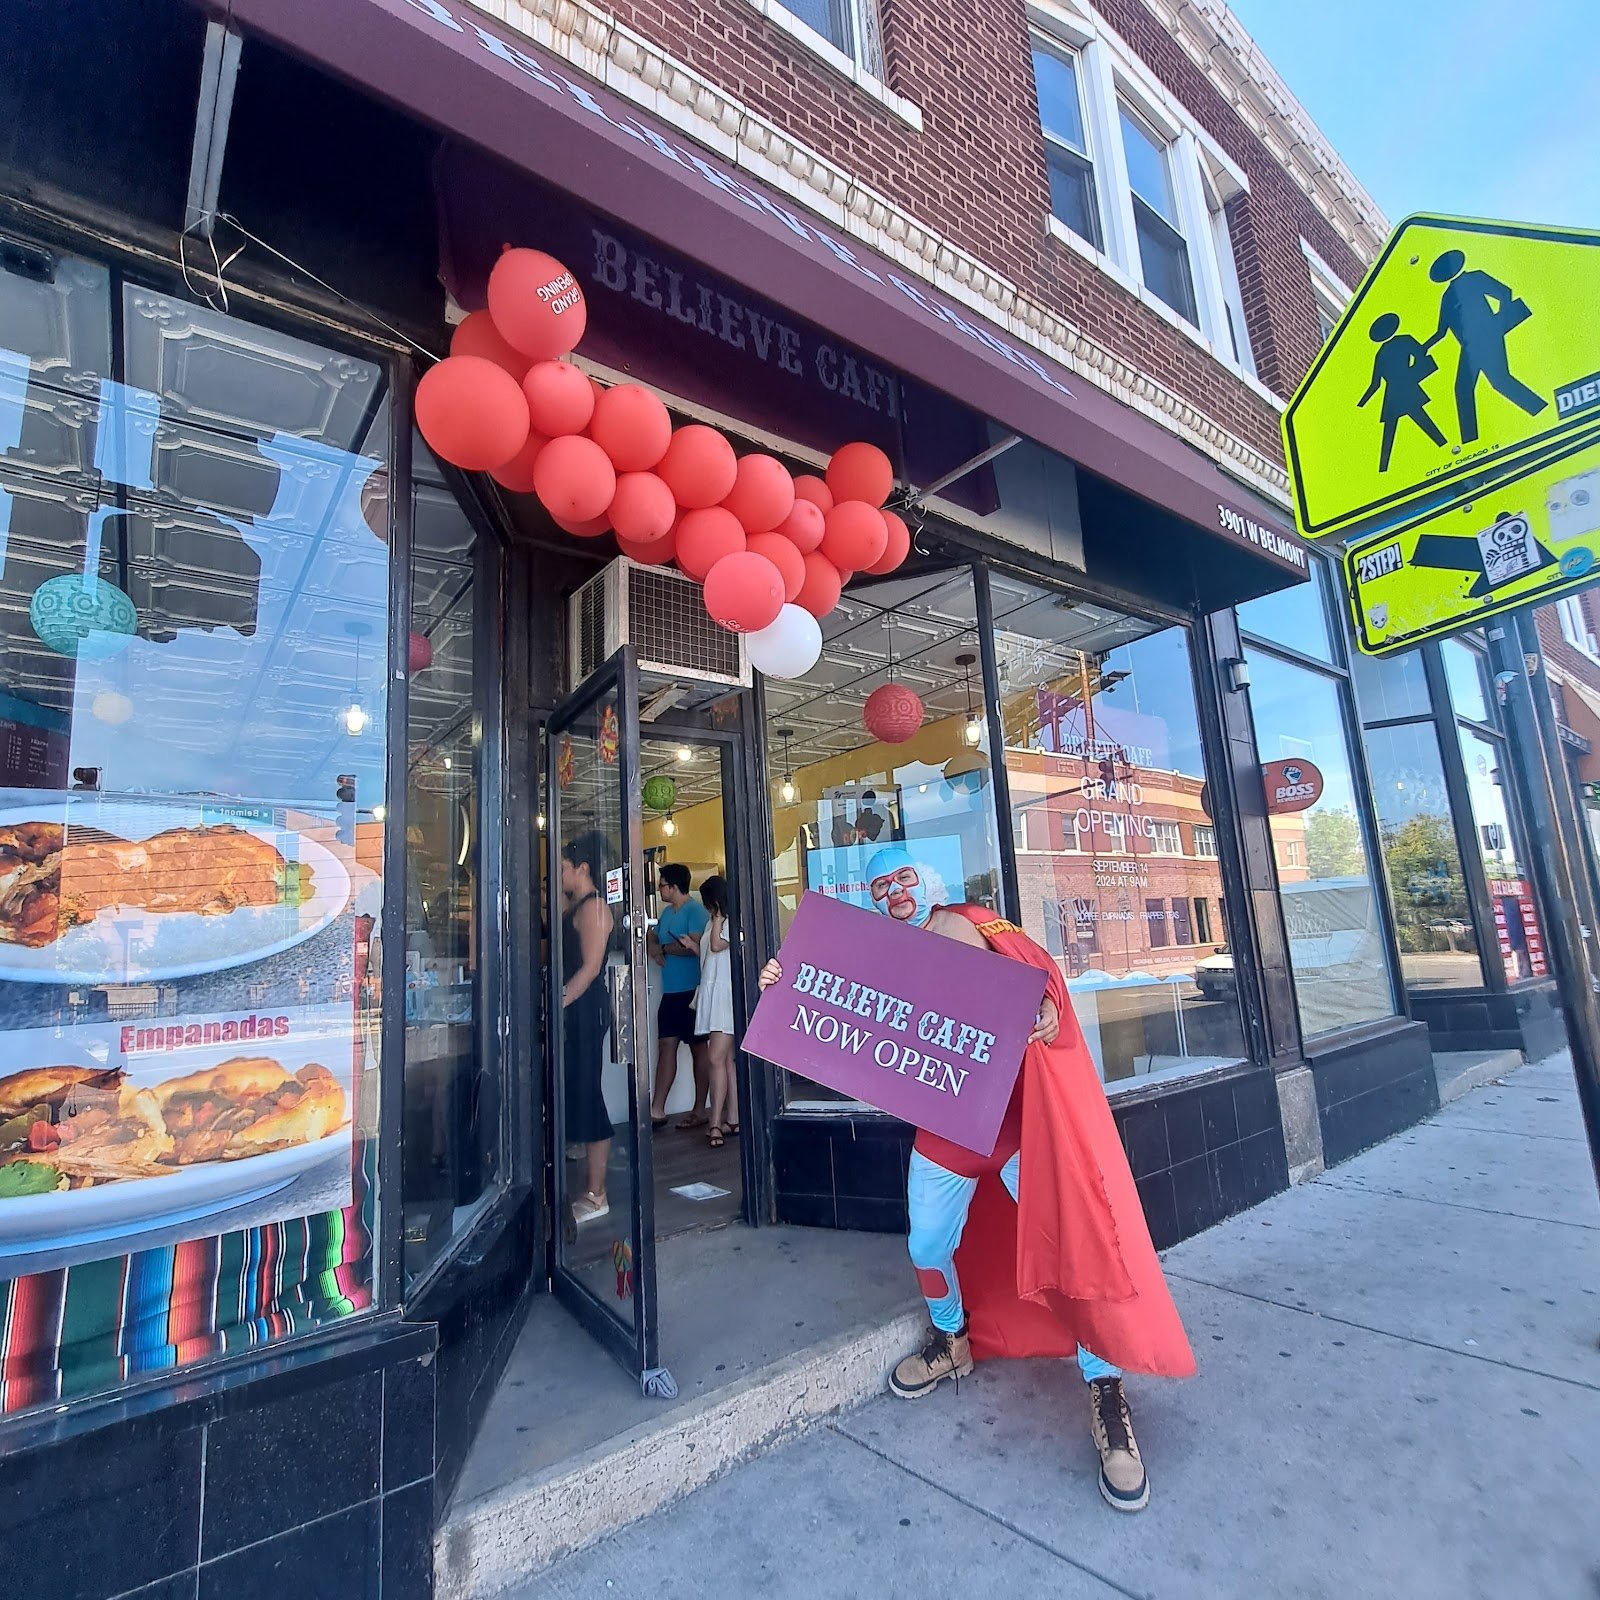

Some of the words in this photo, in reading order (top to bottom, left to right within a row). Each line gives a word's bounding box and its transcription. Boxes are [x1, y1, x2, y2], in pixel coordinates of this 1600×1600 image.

[536, 271, 574, 302] OPENING
[551, 286, 580, 315] GRAND
[591, 228, 803, 378] BELIEVE
[887, 273, 1077, 400] CAFE
[1556, 379, 1600, 413] DIE
[1425, 467, 1441, 476] CITY
[1443, 462, 1453, 470] OF
[1455, 448, 1489, 465] CHICAGO
[1217, 504, 1247, 538] 3901
[1246, 519, 1258, 544] W
[1258, 526, 1305, 568] BELMONT
[1359, 543, 1402, 583] 2STEP!
[1122, 744, 1153, 767] CAFE
[1080, 776, 1143, 805] GRAND
[1275, 782, 1315, 799] BOSS
[1076, 808, 1157, 838] OPENING
[1092, 860, 1139, 873] SEPTEMBER
[1140, 862, 1149, 873] 14
[1095, 875, 1116, 887] 2024
[1117, 876, 1128, 887] AT
[1129, 876, 1148, 888] 9AM
[1139, 911, 1165, 920] FRAPPES
[791, 962, 914, 1032] BELIEVE
[916, 1010, 996, 1064] CAFE
[119, 1014, 290, 1053] Empanadas
[789, 1004, 873, 1055] NOW
[873, 1039, 970, 1097] OPEN
